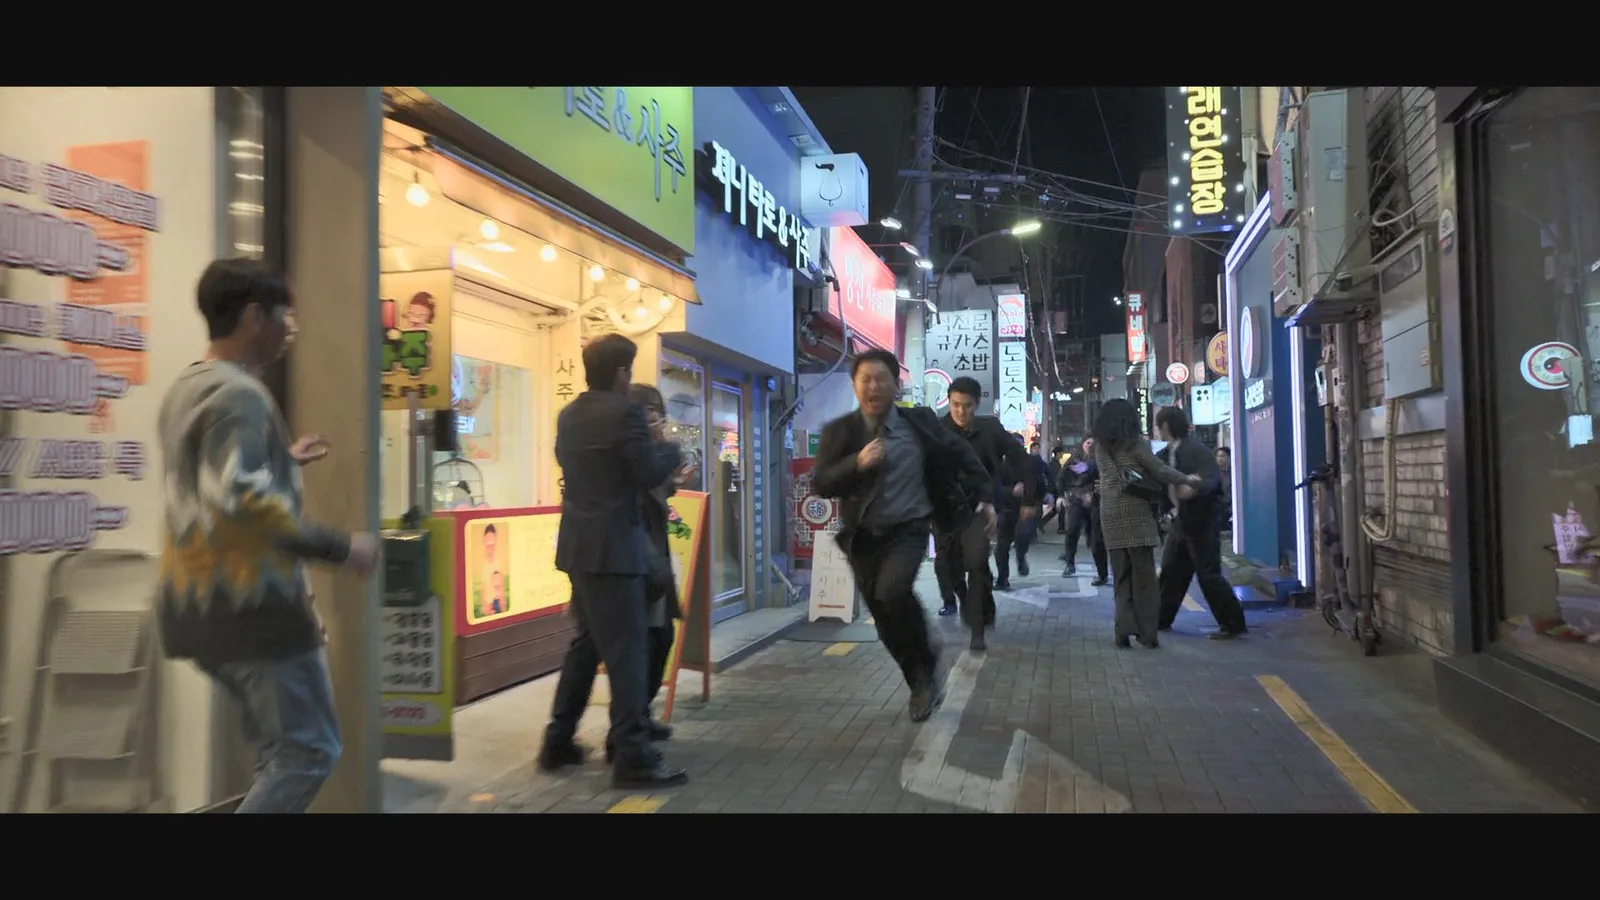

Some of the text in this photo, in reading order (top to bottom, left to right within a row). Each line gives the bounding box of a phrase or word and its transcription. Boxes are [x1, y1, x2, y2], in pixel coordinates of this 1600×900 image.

[565, 86, 686, 203] 로&사주
[936, 332, 990, 352] 규카츠
[954, 352, 991, 371] 초밥
[556, 359, 576, 401] 사주
